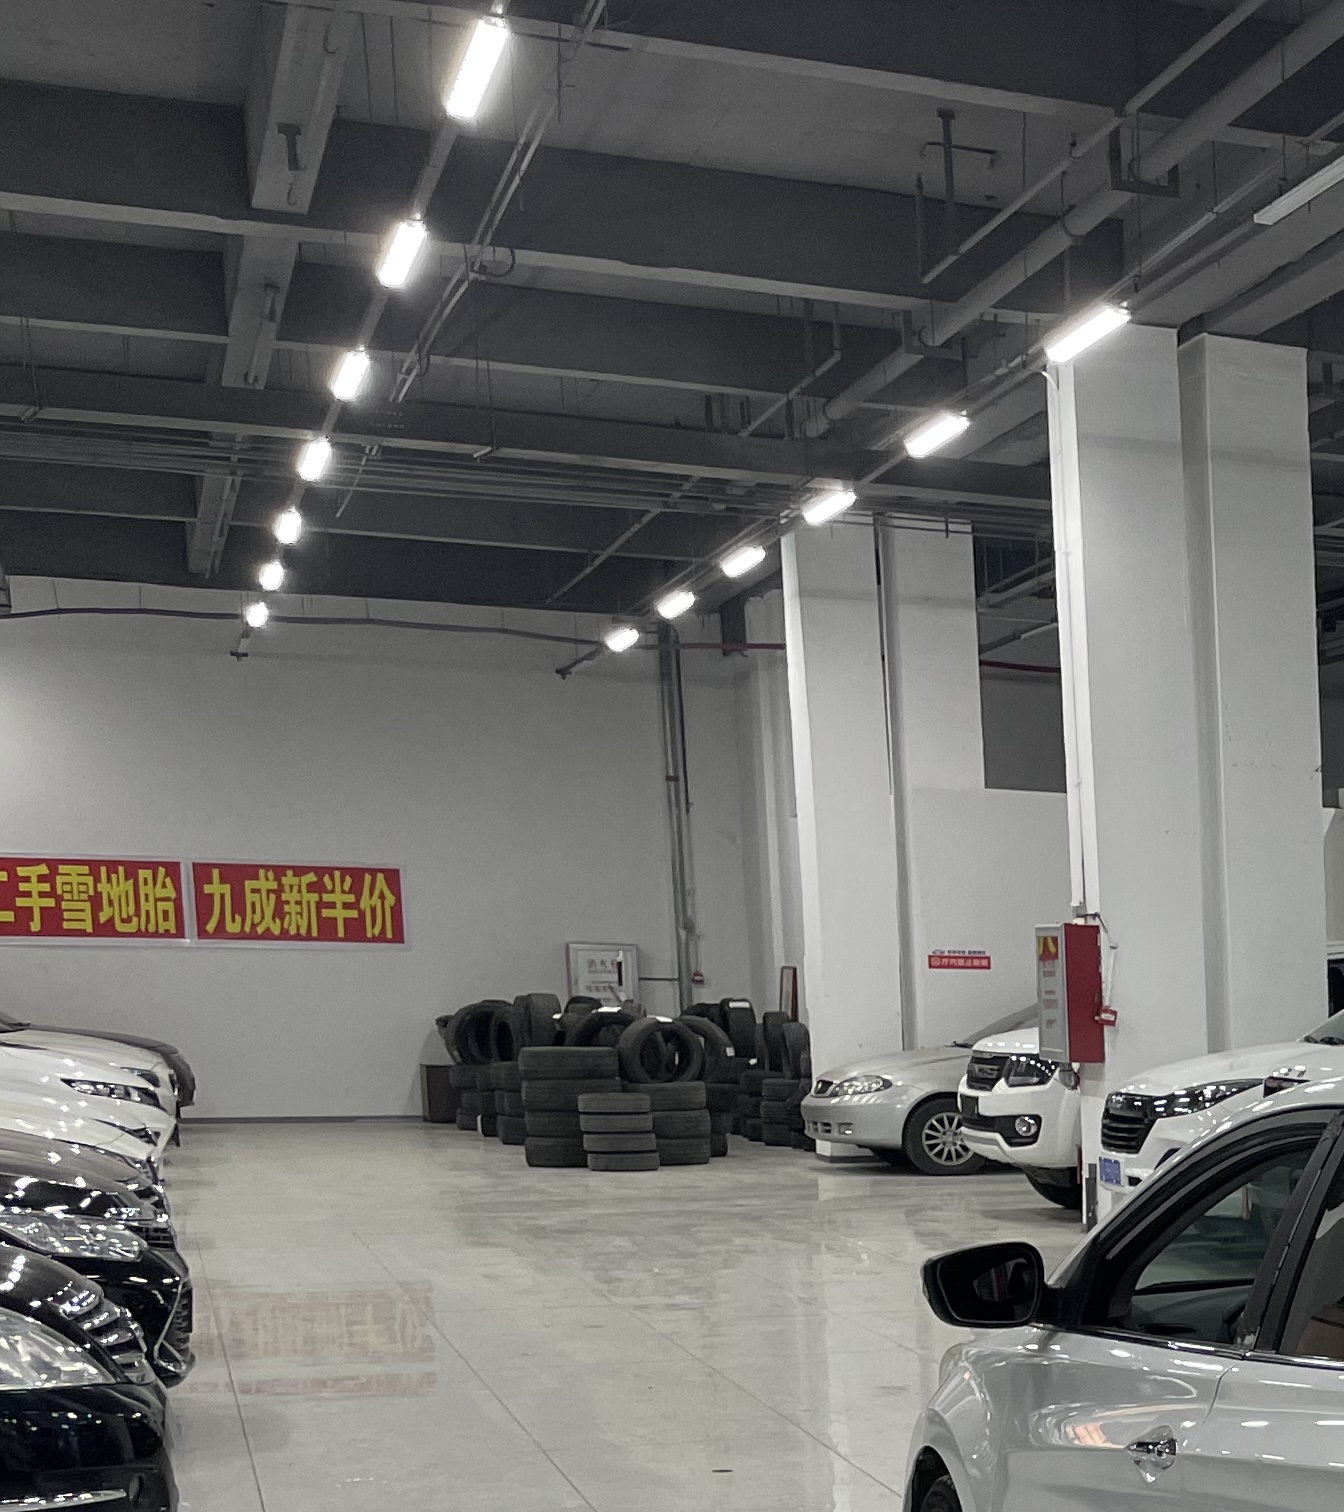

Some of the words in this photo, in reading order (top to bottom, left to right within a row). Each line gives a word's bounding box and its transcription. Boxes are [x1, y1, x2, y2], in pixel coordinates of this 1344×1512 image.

[203, 868, 397, 939] 九成新半价
